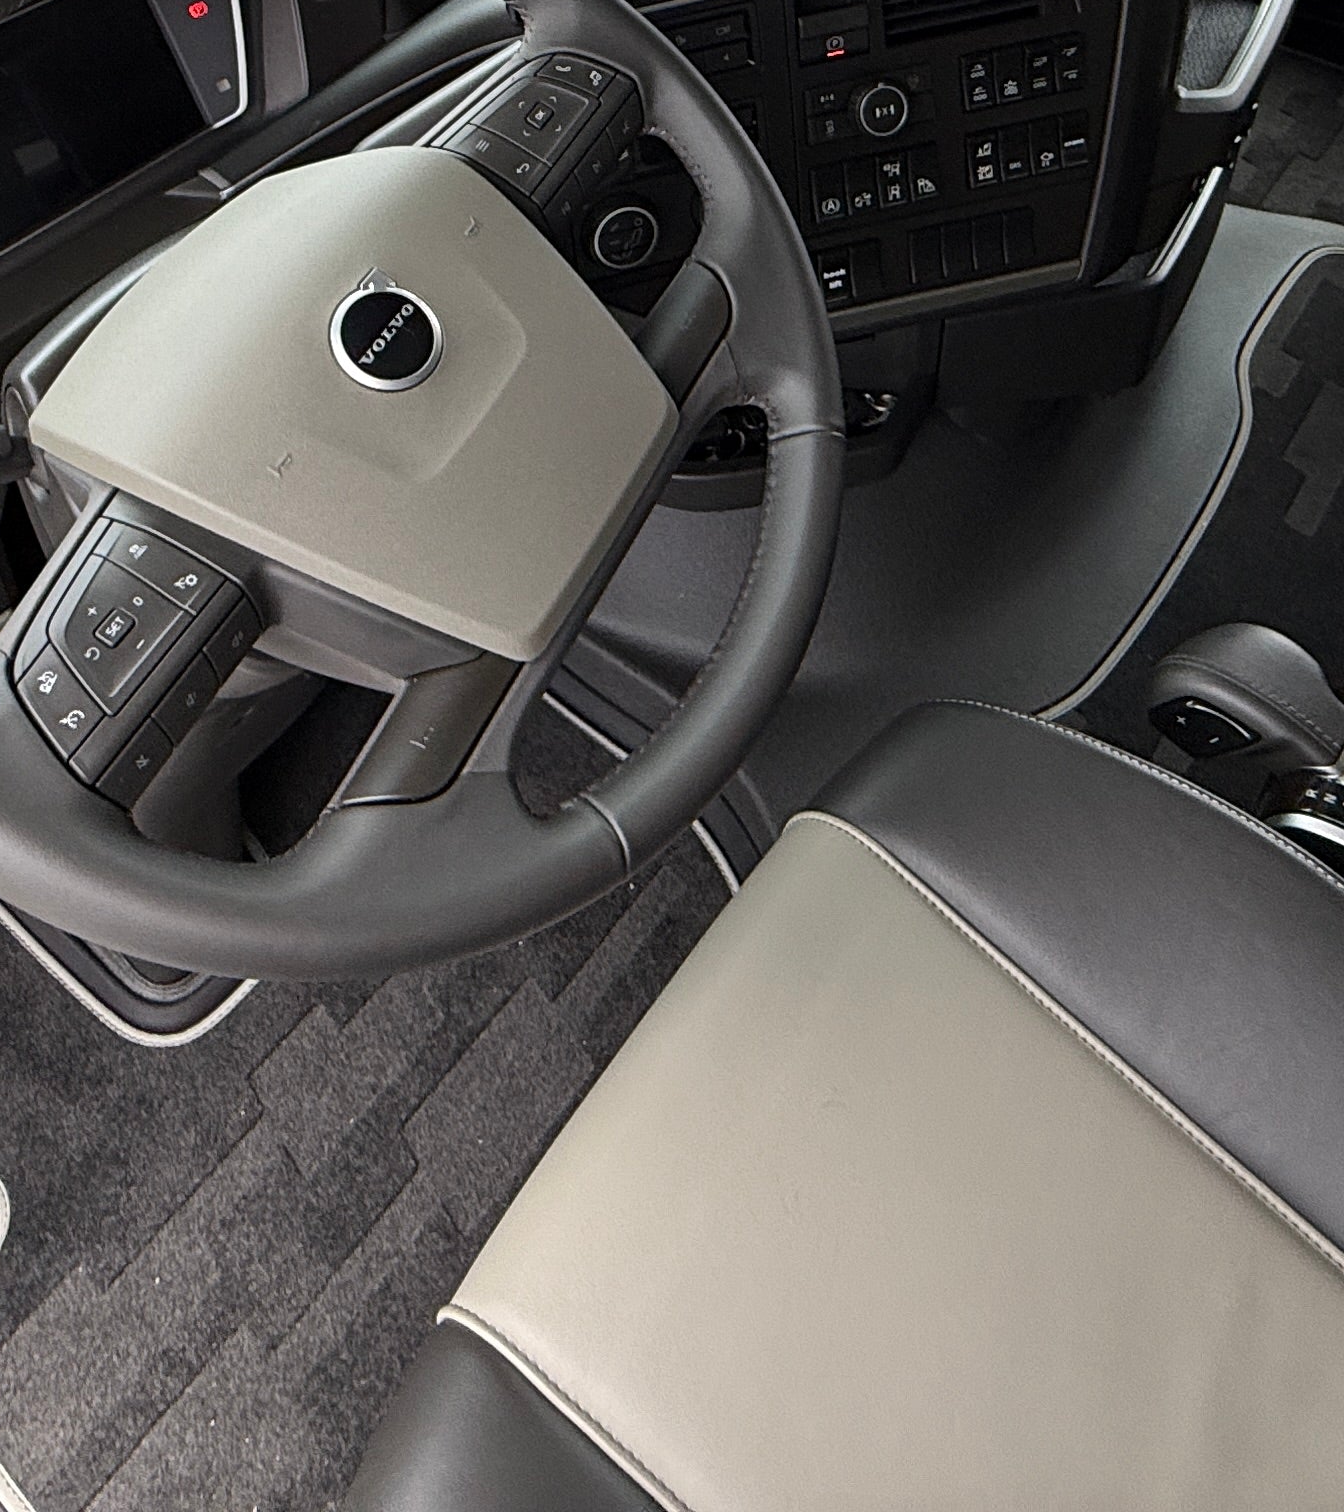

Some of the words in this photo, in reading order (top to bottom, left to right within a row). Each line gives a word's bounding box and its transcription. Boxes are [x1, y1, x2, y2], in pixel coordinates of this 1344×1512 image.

[823, 268, 846, 279] hook
[358, 303, 414, 364] VOLVO
[106, 615, 125, 637] SET
